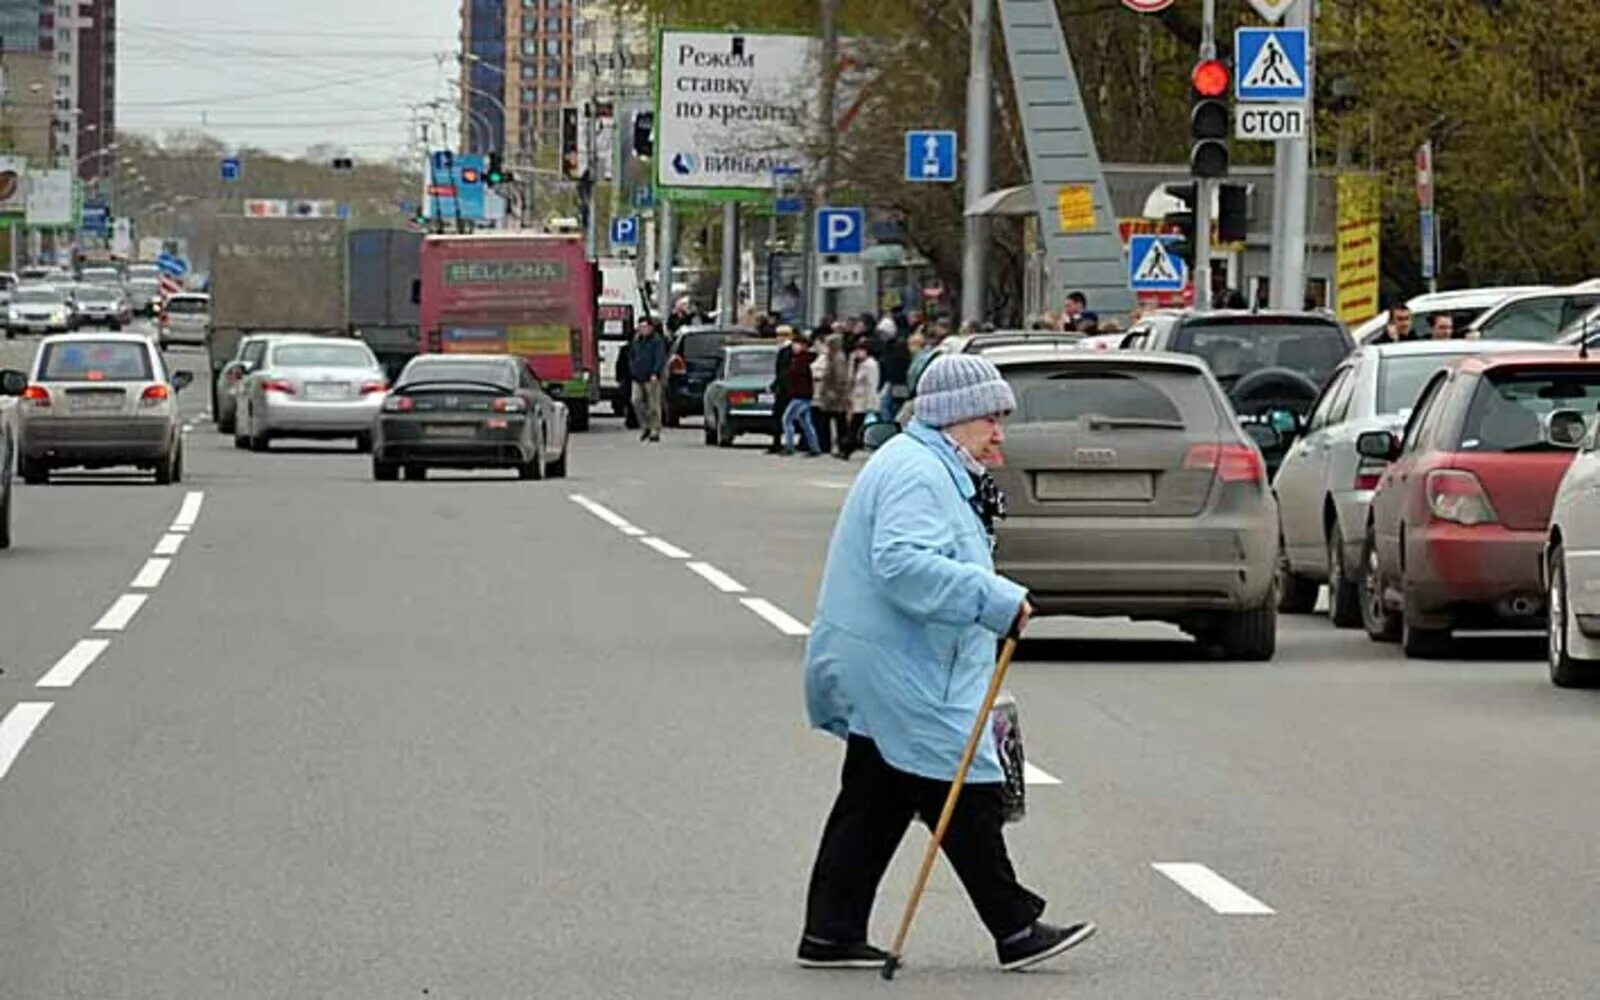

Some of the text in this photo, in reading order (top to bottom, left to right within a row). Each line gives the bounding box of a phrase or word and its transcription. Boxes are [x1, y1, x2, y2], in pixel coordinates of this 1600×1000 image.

[678, 44, 755, 68] Режем
[676, 75, 752, 100] ставку
[675, 102, 703, 119] по
[1242, 111, 1300, 133] СТОП
[617, 219, 633, 241] P
[828, 214, 855, 250] P
